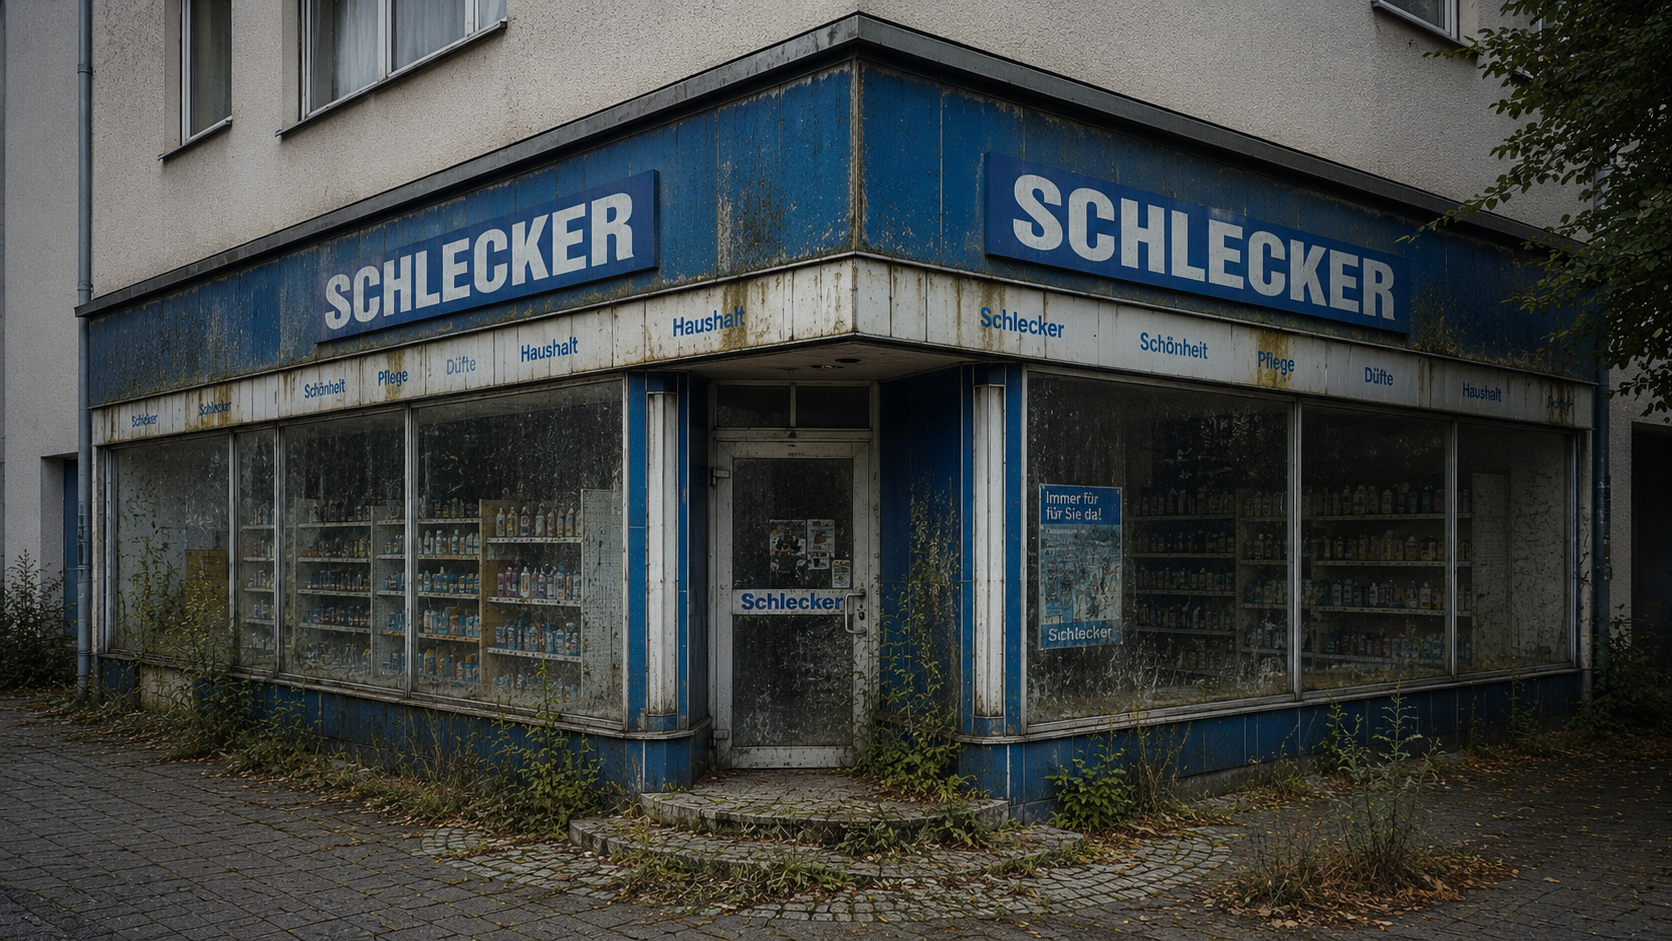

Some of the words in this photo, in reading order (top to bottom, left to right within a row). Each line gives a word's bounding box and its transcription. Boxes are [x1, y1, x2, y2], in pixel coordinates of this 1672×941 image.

[1012, 174, 1396, 321] SCHLECKER
[325, 192, 635, 330] SCHLECKER
[672, 305, 746, 338] Haushalt
[980, 306, 1065, 339] Schlecker
[521, 336, 578, 363] Haushalt
[1140, 332, 1208, 360] Schönheit
[446, 355, 477, 375] Düfte
[1257, 350, 1295, 376] Pflege
[1364, 366, 1394, 386] Düfte
[1462, 381, 1502, 402] Haushalt
[1046, 491, 1081, 504] Immer
[1065, 507, 1081, 520] Sie
[1084, 508, 1102, 521] da!
[741, 593, 844, 610] Schlecker
